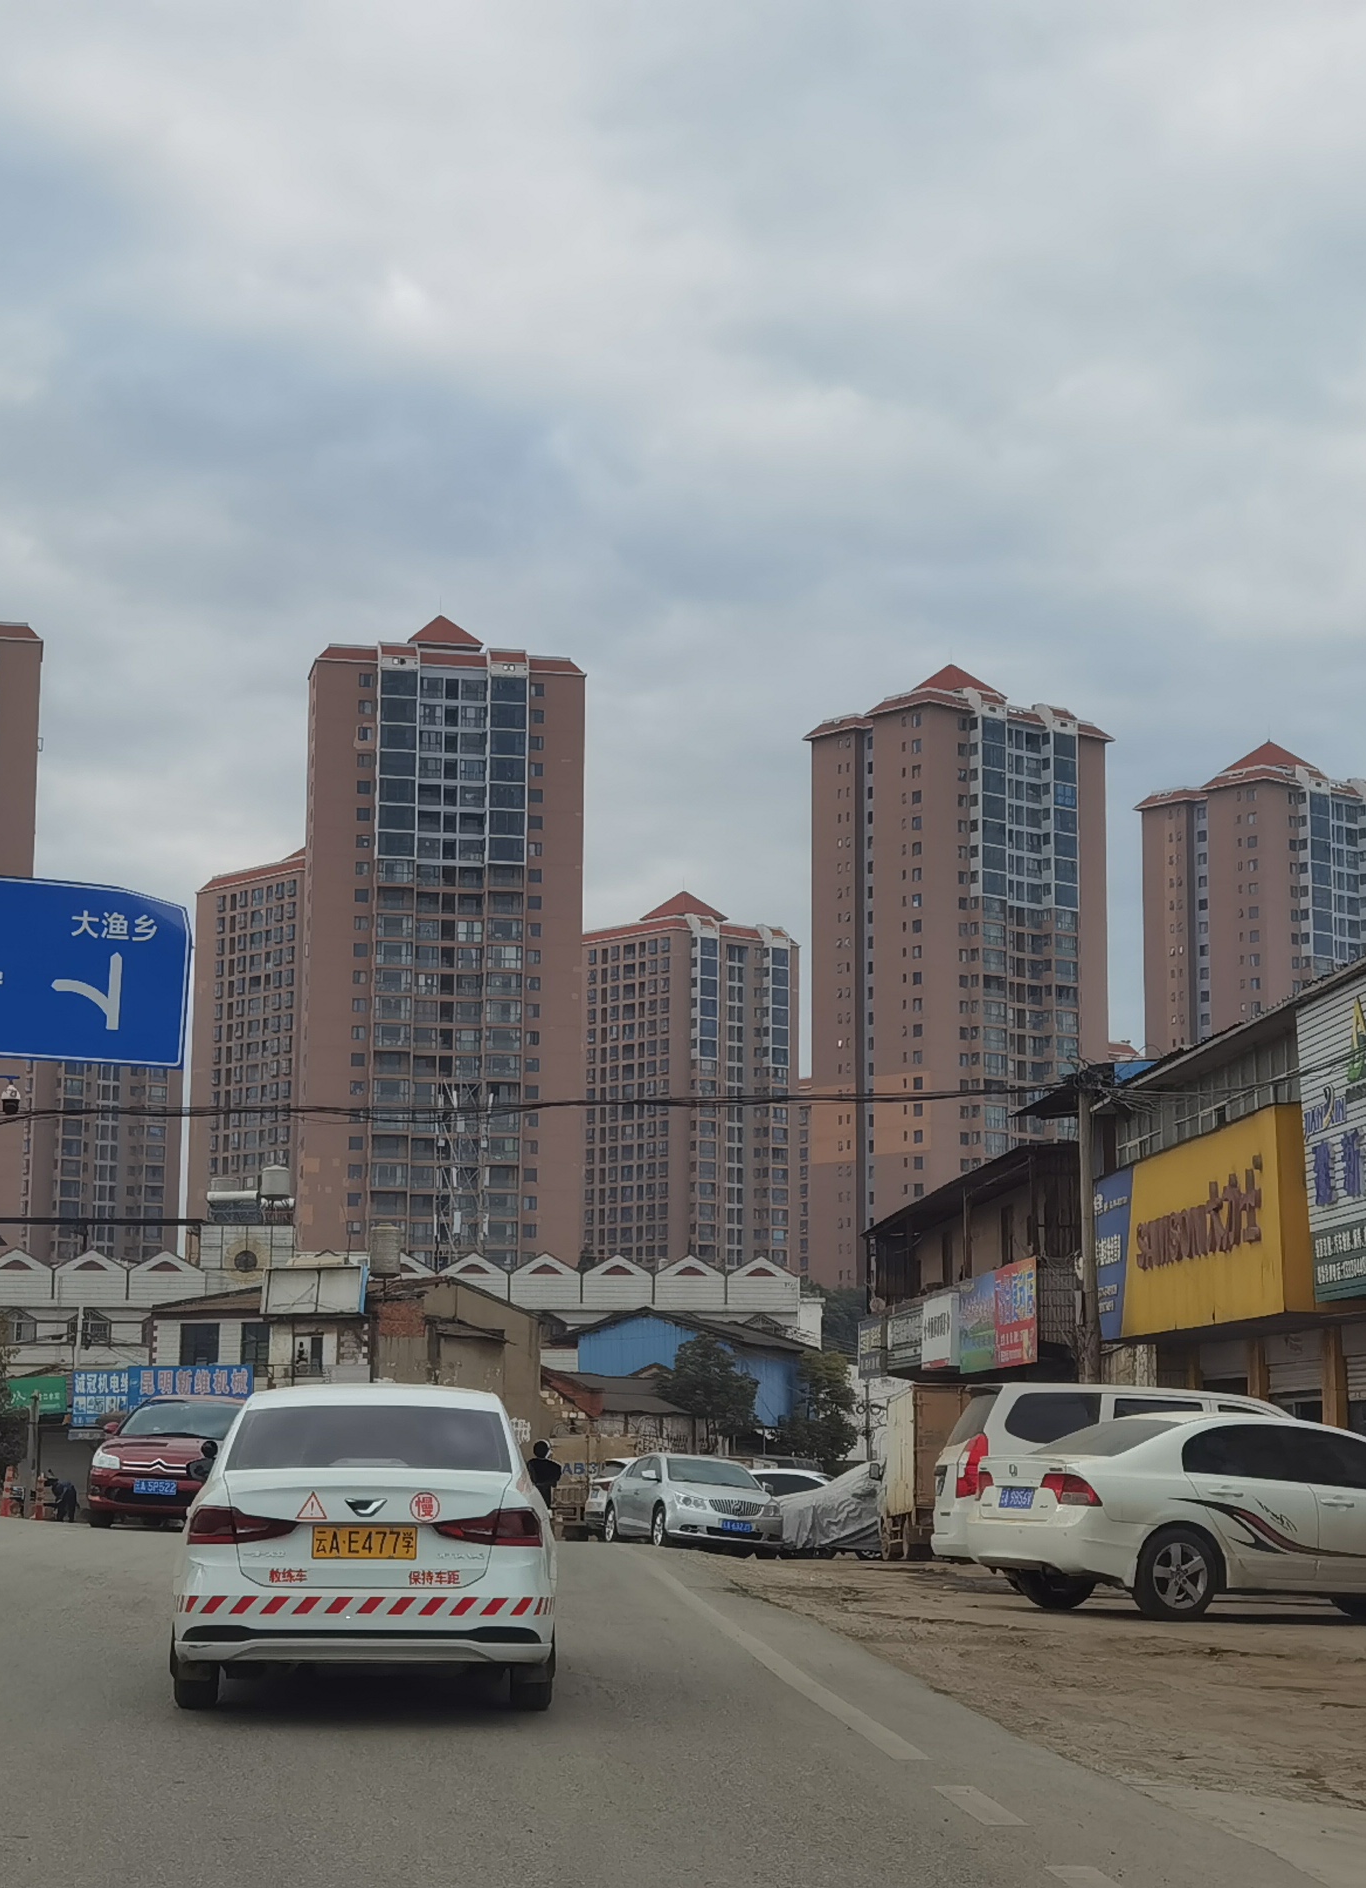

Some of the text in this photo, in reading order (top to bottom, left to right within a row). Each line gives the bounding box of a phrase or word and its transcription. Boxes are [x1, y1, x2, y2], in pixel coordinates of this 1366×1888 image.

[71, 910, 158, 942] 大渔乡
[139, 1368, 249, 1396] 昆明新维机械
[415, 1497, 435, 1519] 慢
[269, 1569, 308, 1584] 教练车
[408, 1570, 461, 1586] 保持车距
